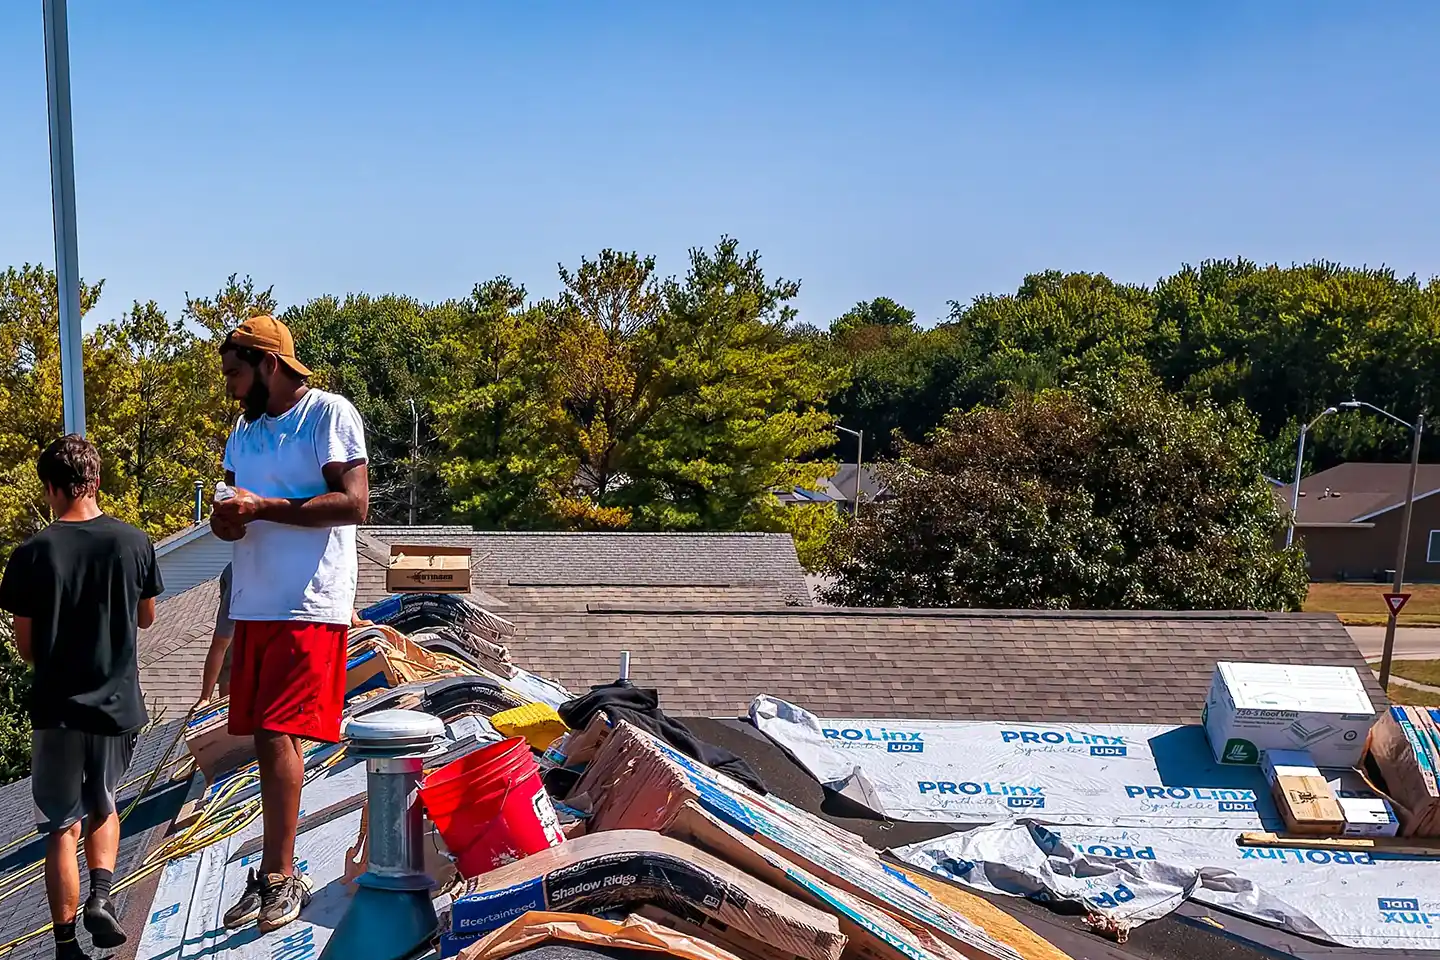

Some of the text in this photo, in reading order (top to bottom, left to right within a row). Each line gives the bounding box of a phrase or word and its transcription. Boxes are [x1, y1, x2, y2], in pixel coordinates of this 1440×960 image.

[822, 728, 925, 742] ROLinx
[1000, 731, 1128, 745] PROLinx
[891, 743, 920, 752] UDL
[1093, 747, 1123, 756] UDL
[917, 781, 1047, 797] PROLinx
[1124, 785, 1258, 800] PROLinx
[1012, 799, 1043, 808] UDL
[1222, 802, 1255, 811] UDL
[551, 874, 636, 902] Shadow Ridge
[1382, 899, 1415, 909] UDL
[470, 900, 537, 927] certainteed
